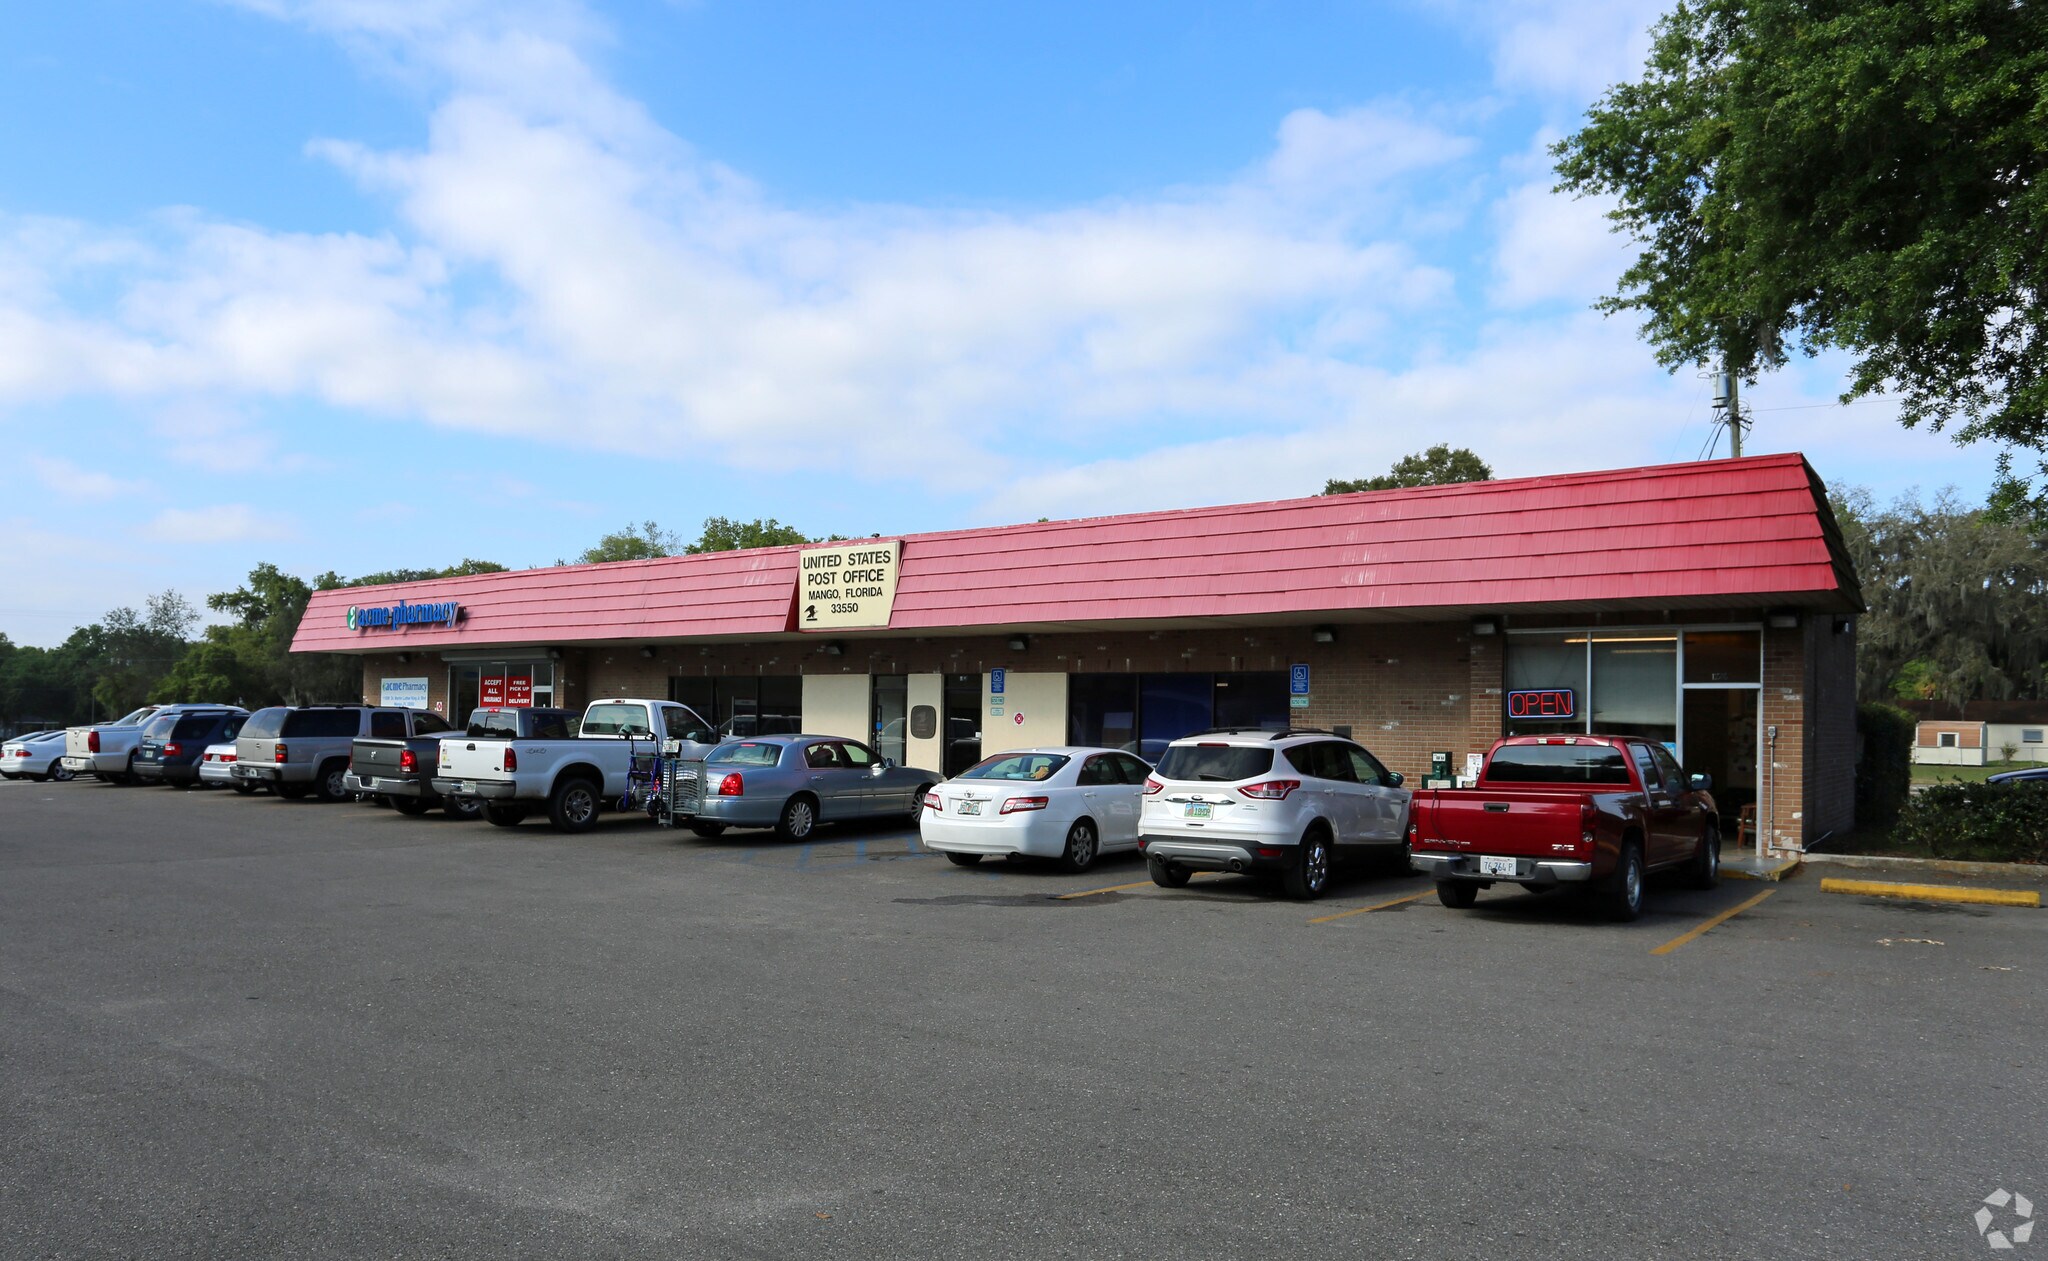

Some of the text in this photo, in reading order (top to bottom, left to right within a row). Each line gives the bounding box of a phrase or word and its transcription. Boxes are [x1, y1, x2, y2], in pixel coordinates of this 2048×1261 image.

[803, 550, 891, 569] UNITED STATES
[808, 569, 884, 586] POST OFFICE
[809, 587, 883, 600] MANGO, FLORIDA
[358, 607, 389, 627] acme
[392, 600, 458, 631] pharmacy
[831, 603, 858, 613] 33550
[1511, 692, 1571, 715] OPEN
